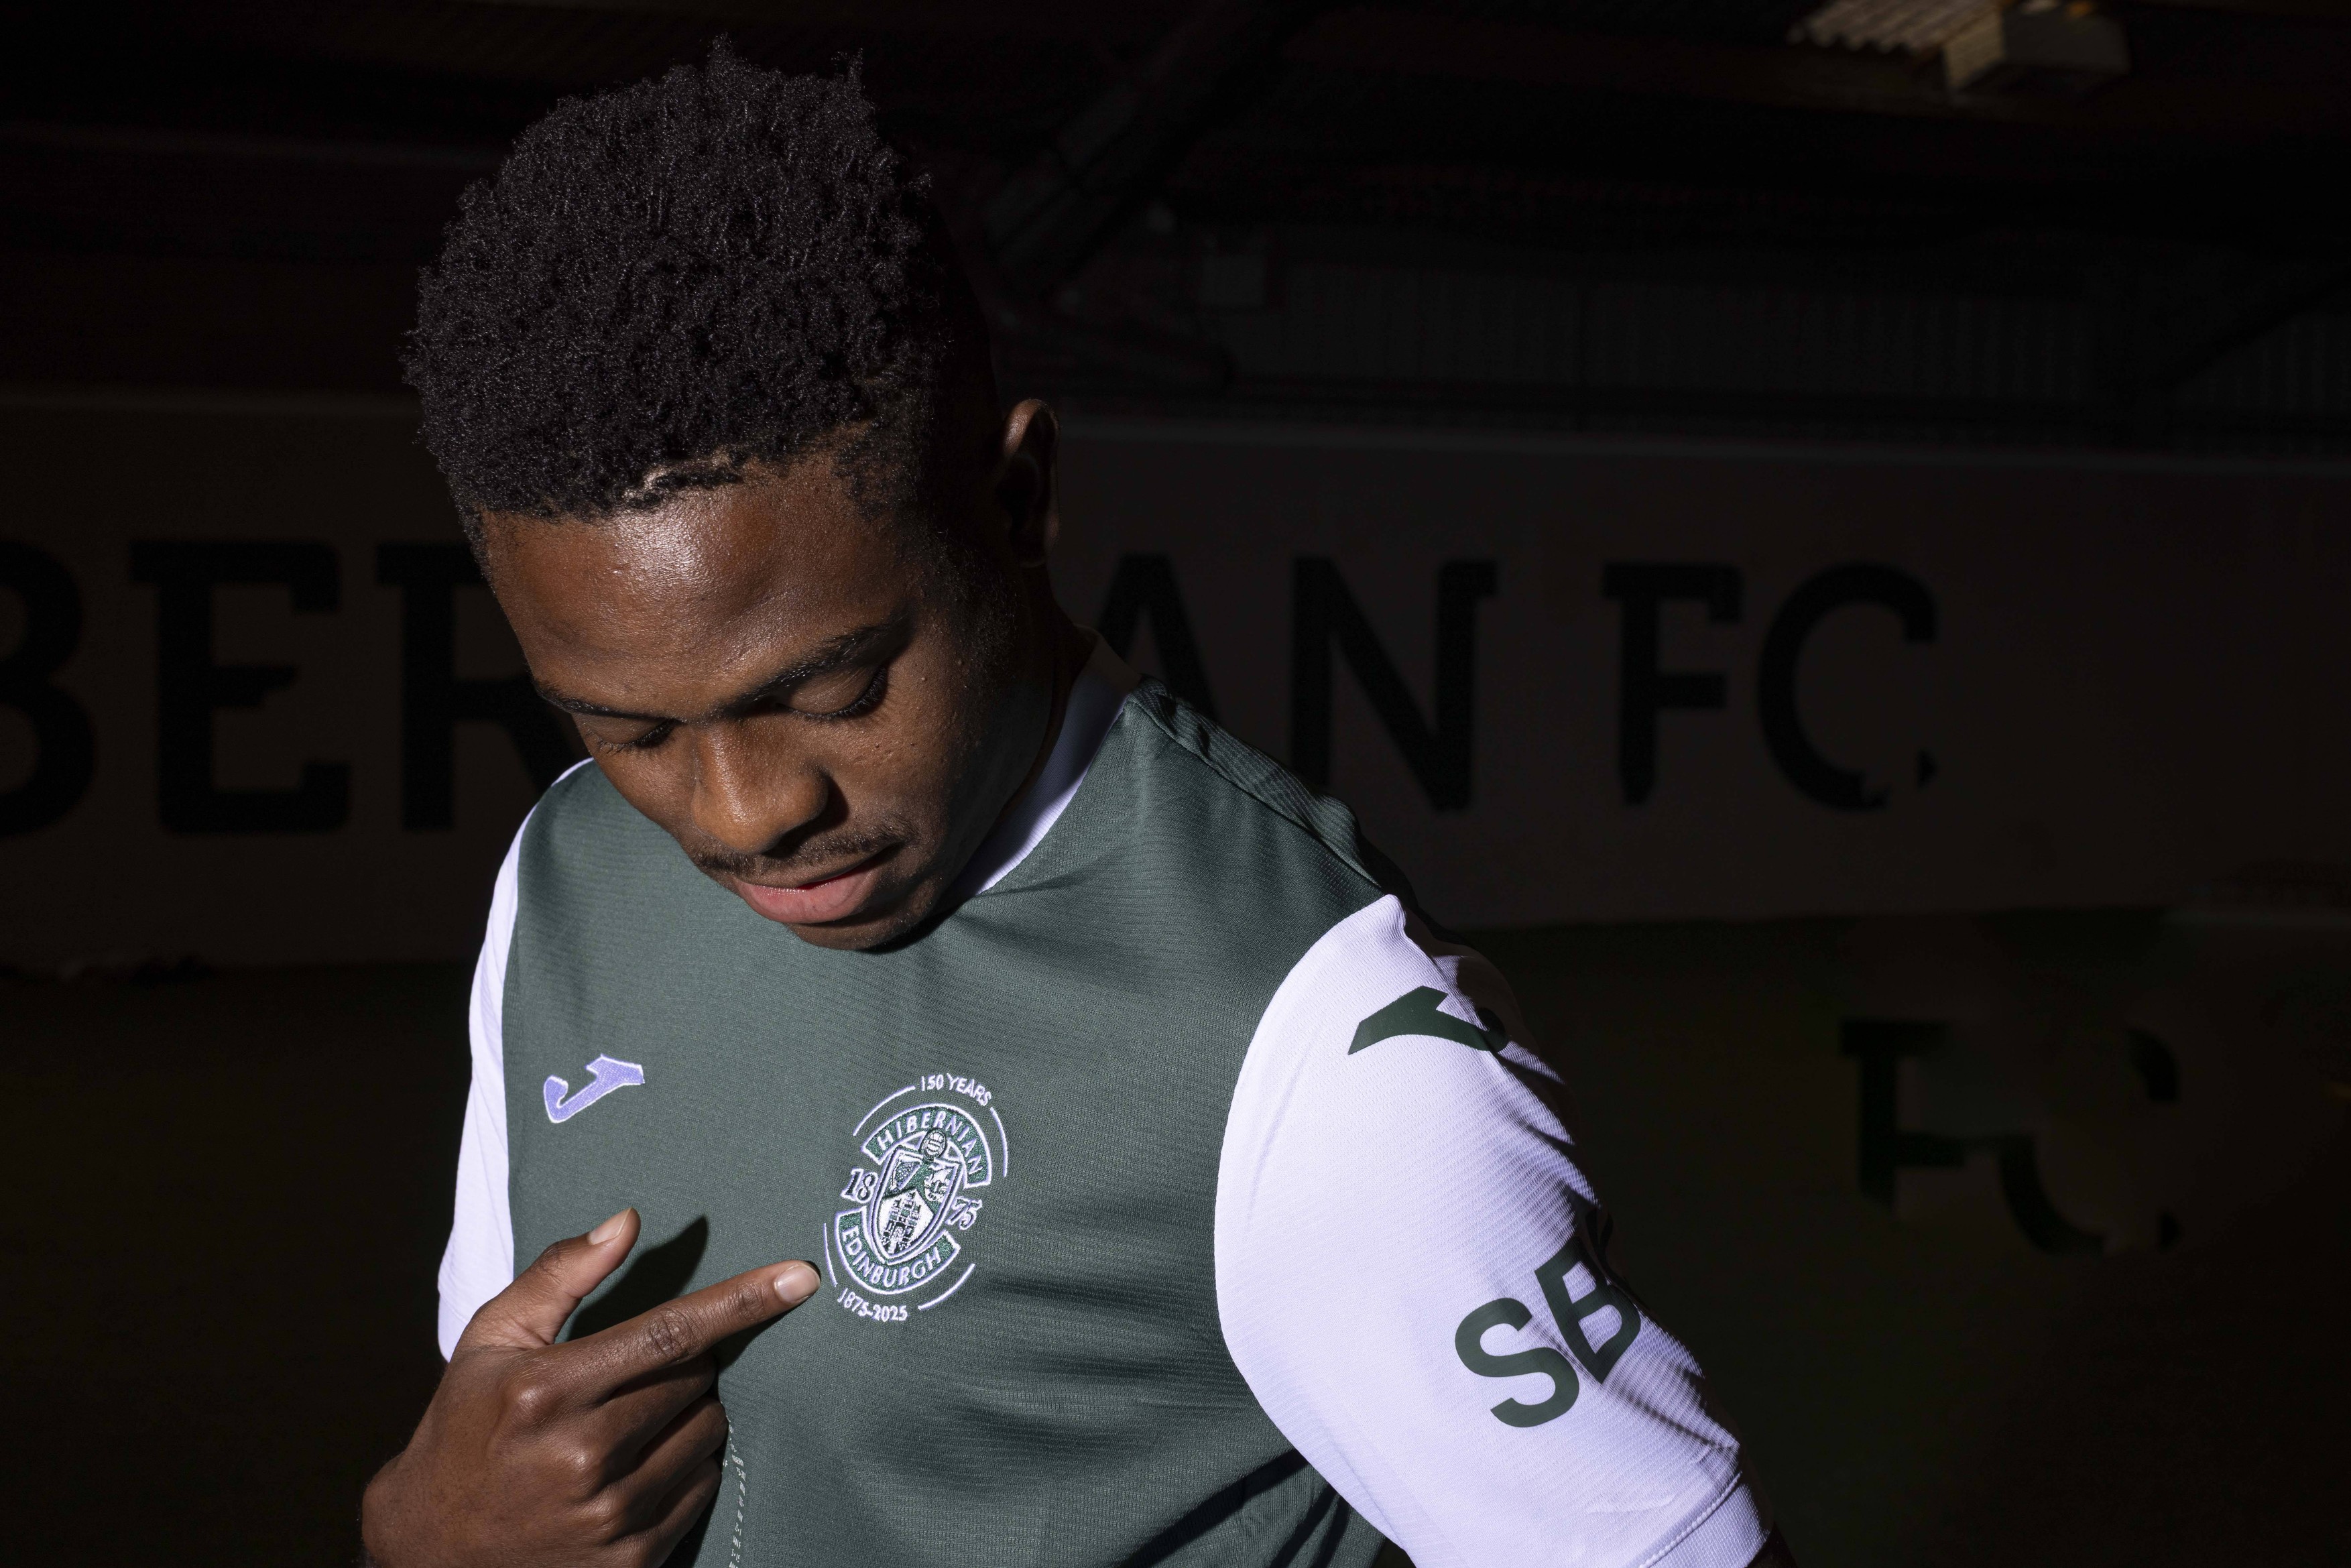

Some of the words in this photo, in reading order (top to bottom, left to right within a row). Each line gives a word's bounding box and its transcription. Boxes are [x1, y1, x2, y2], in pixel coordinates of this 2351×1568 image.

[1602, 560, 1937, 811] FC
[920, 1074, 944, 1091] 150
[947, 1072, 993, 1107] YEARS
[877, 1109, 984, 1175] HIBERNIAN
[841, 1168, 879, 1203] 18
[841, 1224, 942, 1288] EDINBURGH
[837, 1287, 908, 1322] 1875-2025
